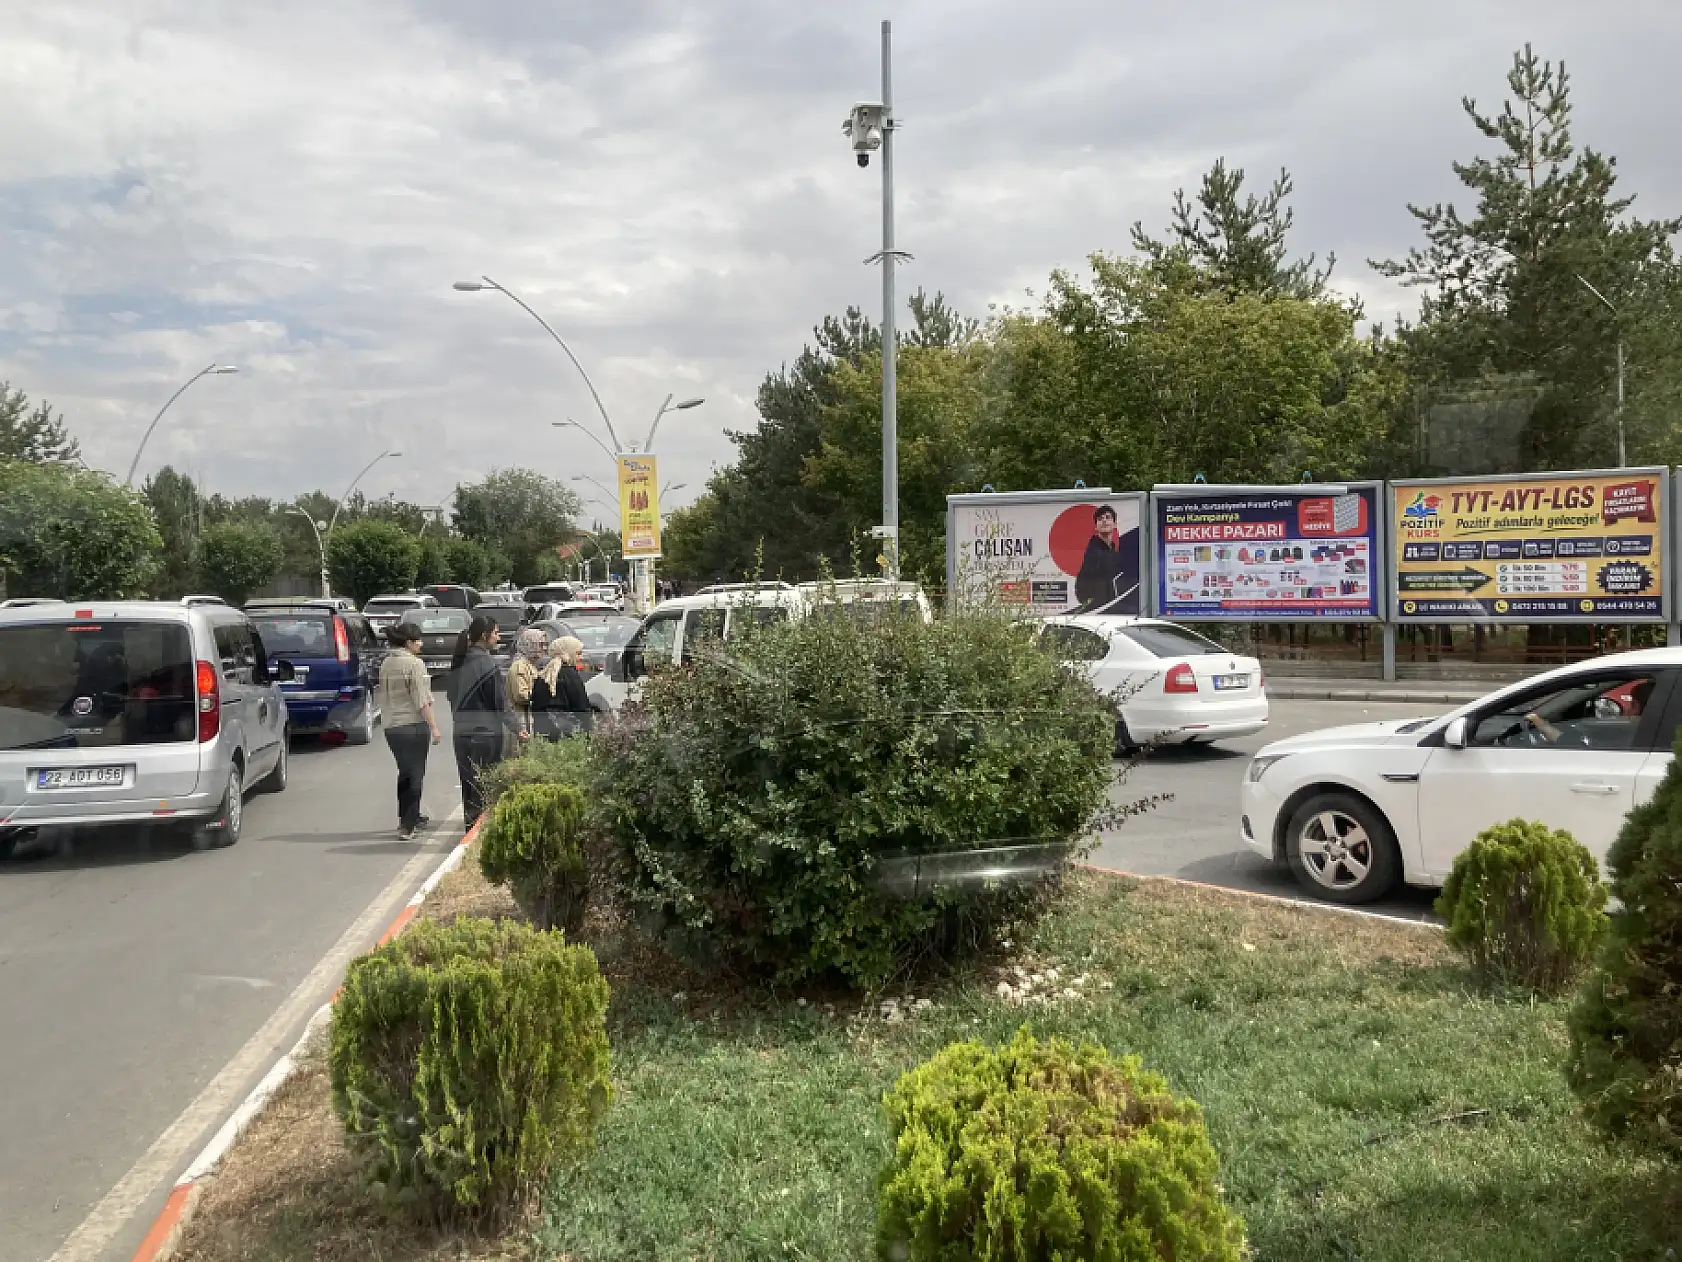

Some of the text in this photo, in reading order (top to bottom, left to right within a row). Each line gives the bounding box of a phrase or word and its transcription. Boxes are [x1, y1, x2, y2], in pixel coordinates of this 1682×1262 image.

[1452, 485, 1595, 513] TYT-AYT-LGS
[1166, 512, 1240, 524] Dev Kampanya
[1400, 515, 1445, 529] POZİTİF
[1455, 516, 1492, 529] Pozitif
[1167, 523, 1284, 540] MEKKE PAZARI
[1407, 529, 1440, 538] KURS
